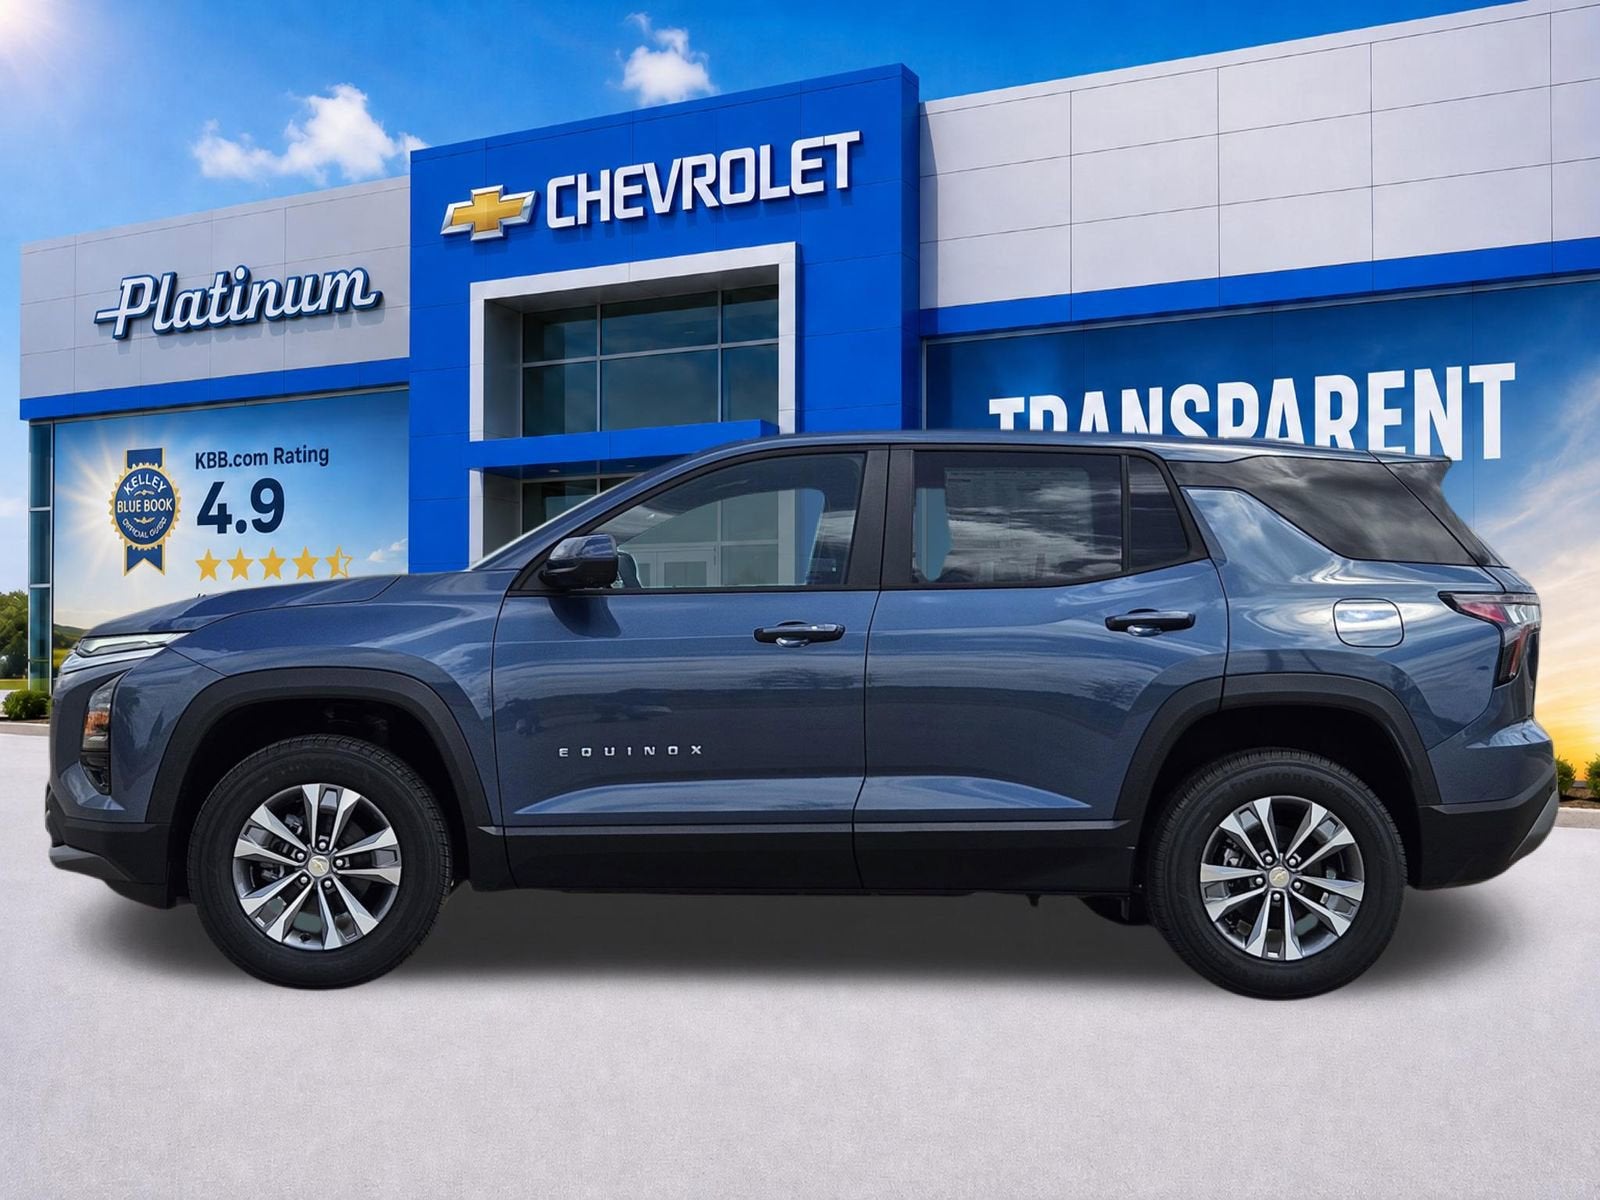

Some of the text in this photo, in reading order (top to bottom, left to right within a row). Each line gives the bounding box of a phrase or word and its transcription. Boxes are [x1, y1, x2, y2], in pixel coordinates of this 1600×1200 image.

[546, 130, 860, 229] CHEVROLET
[94, 264, 383, 340] Platinum
[195, 445, 329, 470] KBB.com Rating
[123, 474, 167, 495] KELLEY
[117, 498, 173, 513] BLUE BOOK
[197, 478, 285, 534] 4.9
[559, 745, 702, 757] EQUINOX
